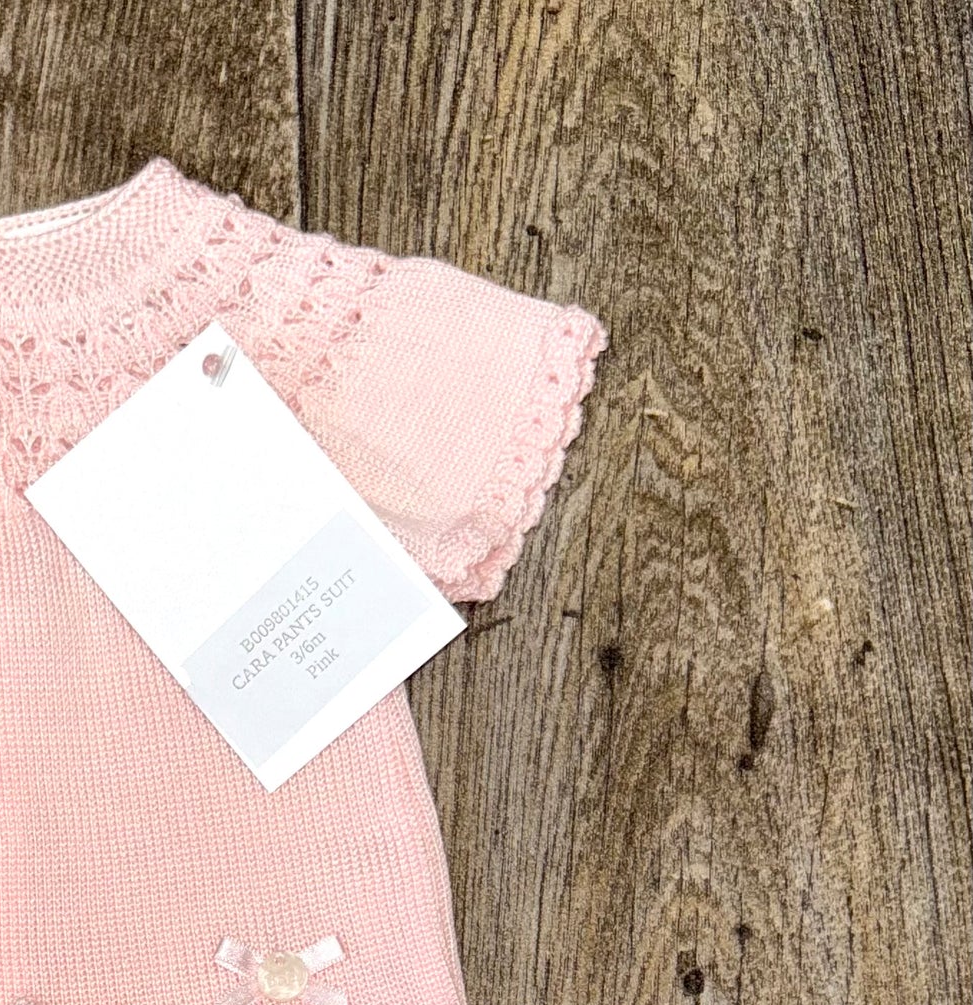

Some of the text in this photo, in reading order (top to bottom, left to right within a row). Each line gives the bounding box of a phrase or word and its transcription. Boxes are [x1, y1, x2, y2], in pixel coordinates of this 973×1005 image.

[232, 569, 356, 690] CARA PANTS SUIT
[240, 576, 320, 653] B009801415
[290, 631, 326, 665] 3/6m
[305, 647, 340, 679] Pink
